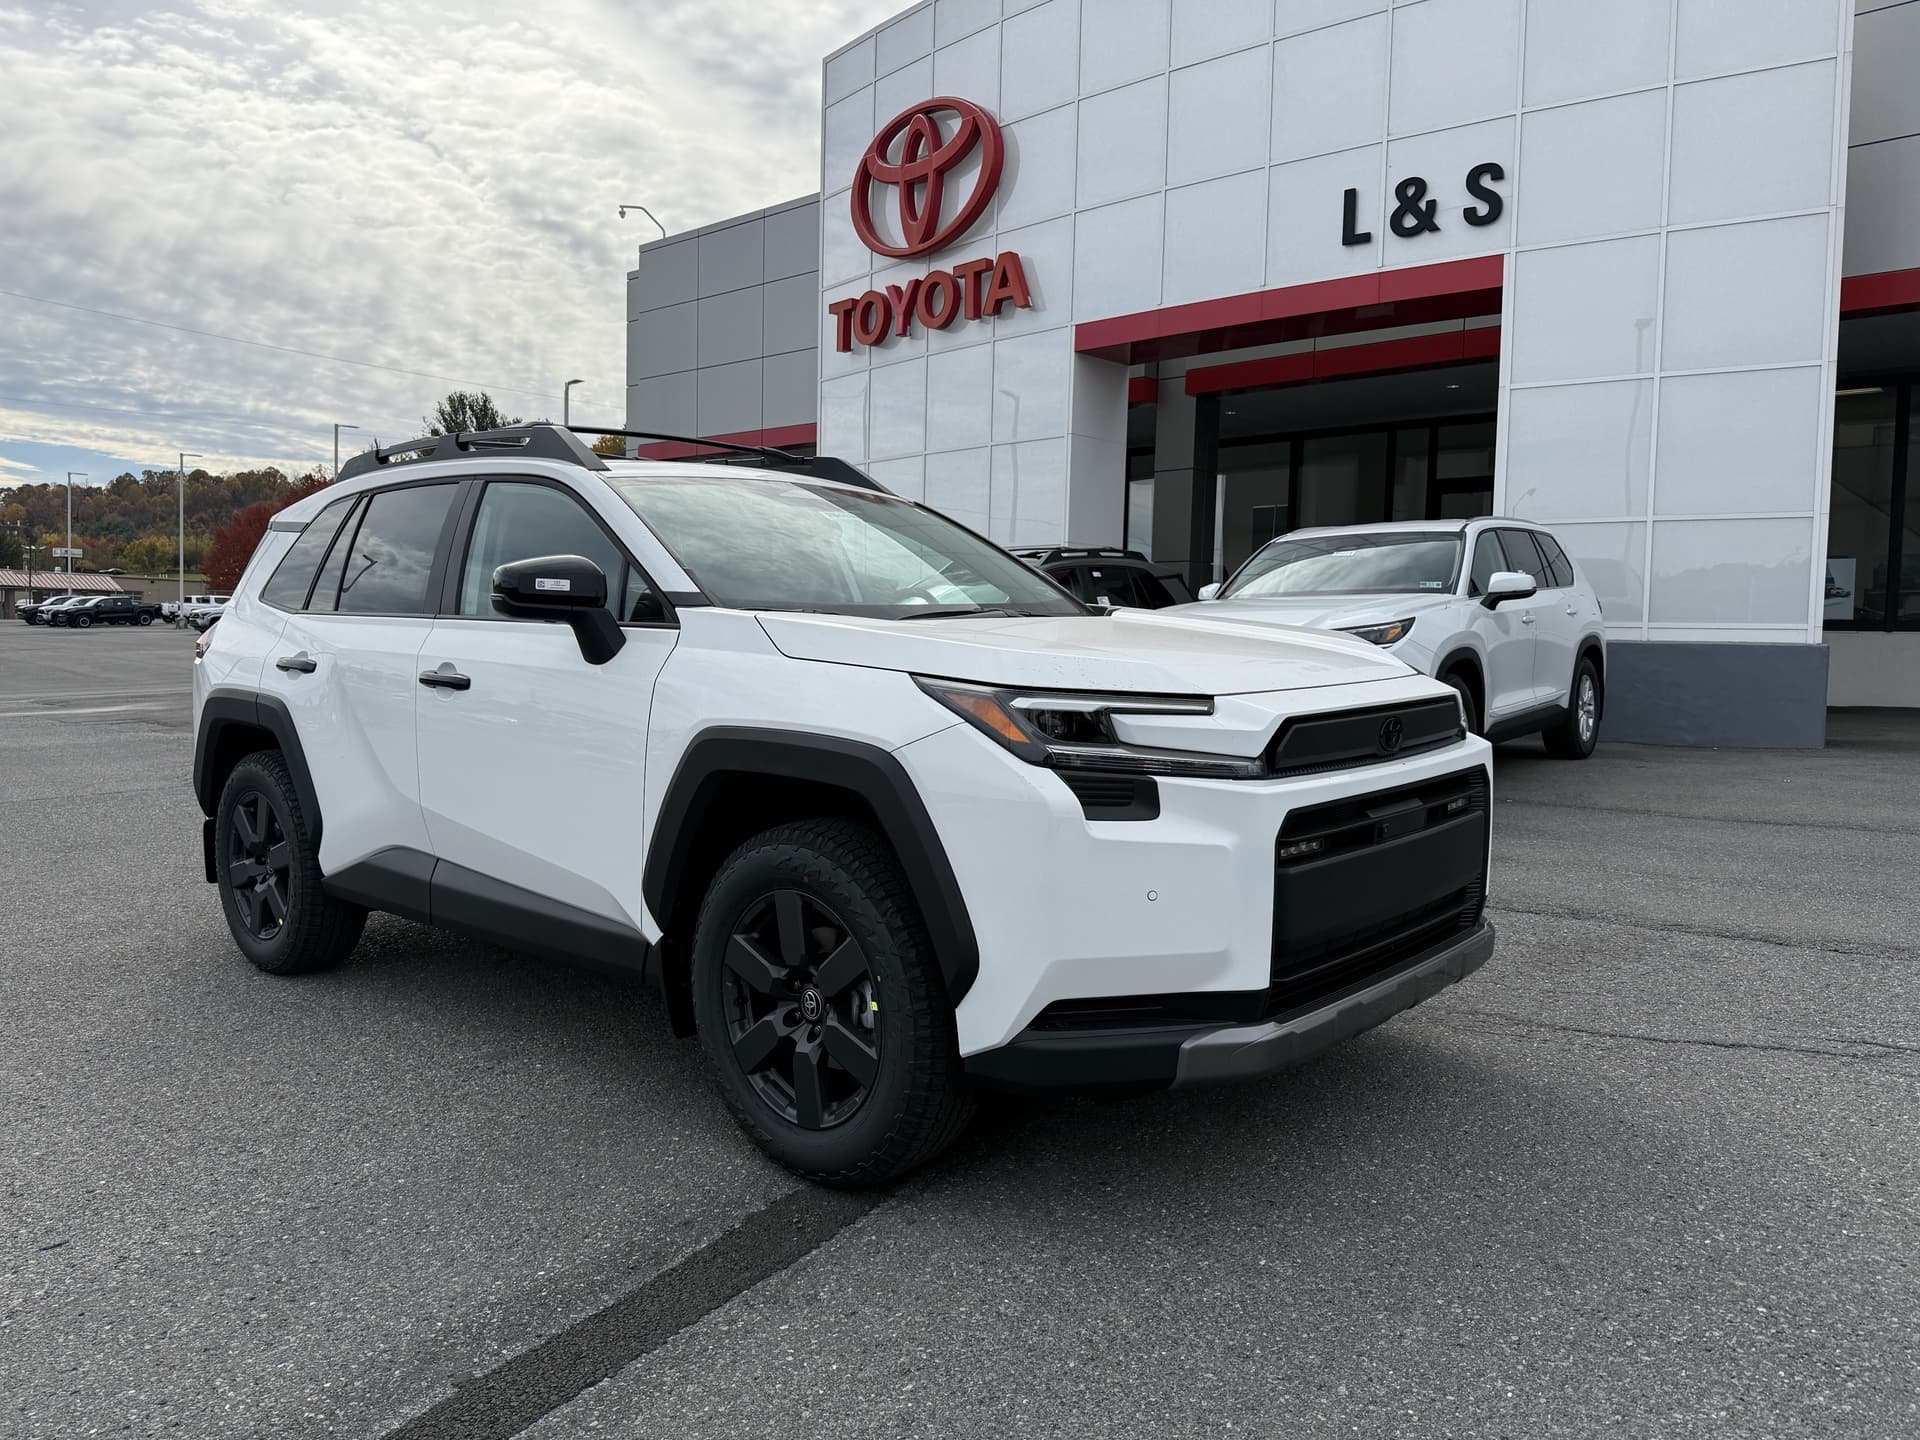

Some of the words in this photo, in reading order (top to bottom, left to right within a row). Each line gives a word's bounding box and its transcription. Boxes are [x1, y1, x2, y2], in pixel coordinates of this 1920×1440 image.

[1342, 188, 1372, 246] L
[1390, 177, 1441, 238] &
[1463, 162, 1505, 226] S
[829, 251, 1031, 353] TOYOTA
